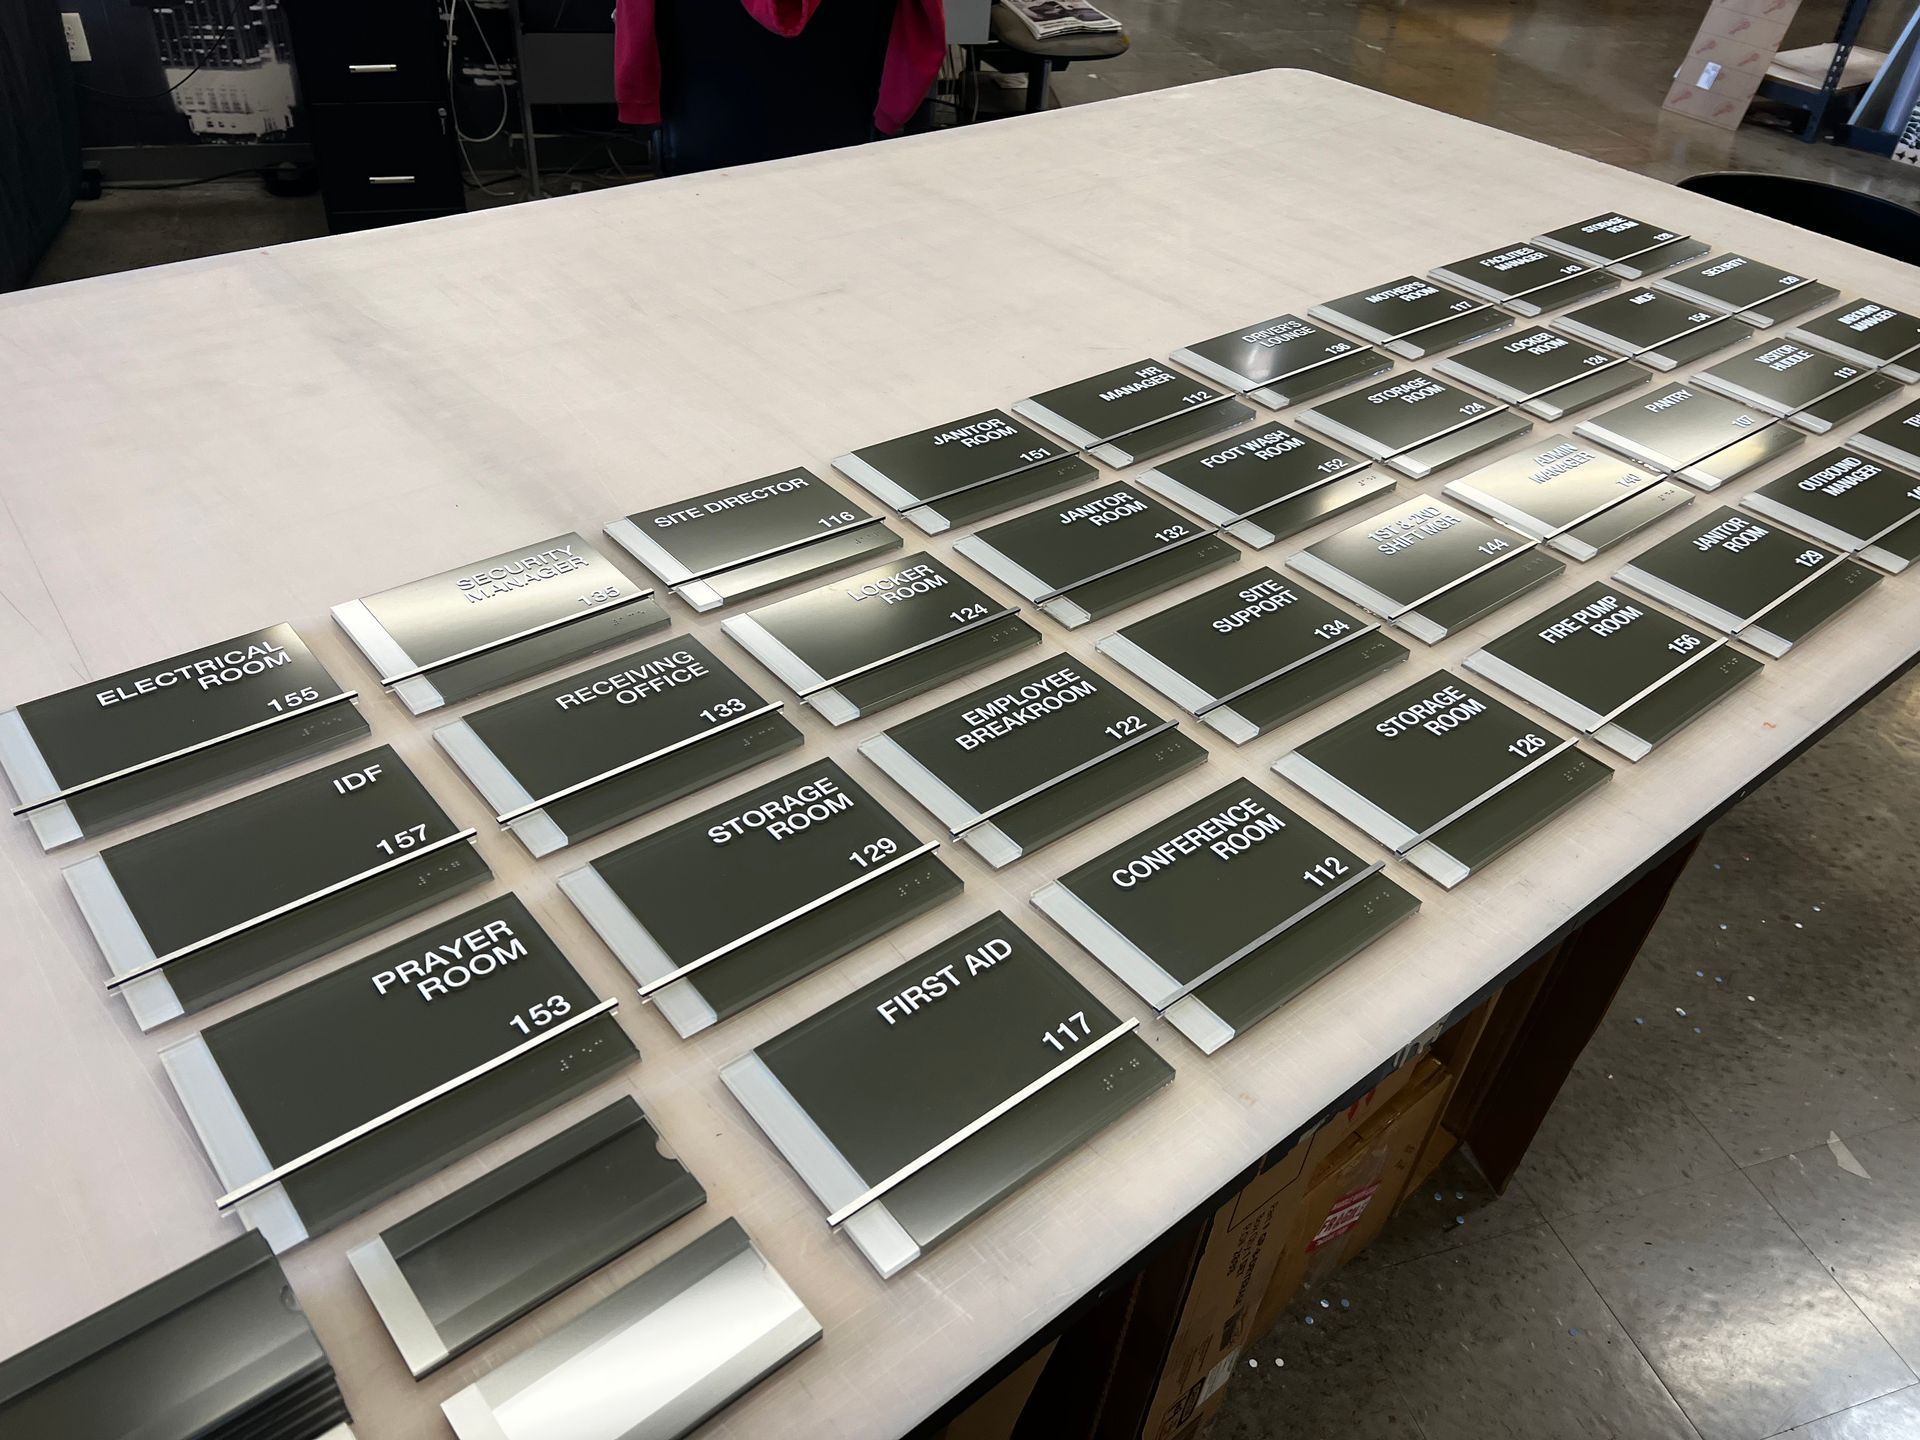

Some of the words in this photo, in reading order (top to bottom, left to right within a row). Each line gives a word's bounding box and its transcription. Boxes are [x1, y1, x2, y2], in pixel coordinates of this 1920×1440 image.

[1580, 216, 1628, 233] STORAGE
[1606, 221, 1640, 233] ROOM
[1480, 248, 1535, 266] FACILITIES
[1494, 252, 1548, 271] MANAGER
[1701, 258, 1747, 277] SECURITY
[1365, 282, 1426, 303] MOTHER'S
[1400, 286, 1439, 302] ROOM
[1450, 301, 1472, 311] 117
[1837, 304, 1881, 324] INBOUND
[1242, 320, 1302, 343] DRIVER'S
[1850, 310, 1898, 331] MANAGER
[1259, 327, 1316, 348] LOUNGE
[1504, 332, 1554, 352] LOCKER
[1528, 338, 1568, 355] ROOM
[1584, 355, 1608, 366] 124
[1754, 344, 1799, 364] VISITOR
[1769, 350, 1814, 372] HUDDLE
[1136, 366, 1162, 378] HR
[1834, 367, 1857, 378] 113
[1099, 373, 1176, 401] MANAGER
[1182, 391, 1212, 404] 112
[1368, 377, 1431, 404] STORAGE
[1401, 384, 1446, 404] ROOM
[1459, 402, 1486, 416] 124
[1644, 389, 1693, 413] PANTRY
[934, 418, 1006, 445] JANITOR
[1732, 415, 1755, 428] 107
[961, 426, 1018, 448] ROOM
[1200, 446, 1245, 468] FOOT
[1241, 430, 1290, 451] WASH
[1255, 438, 1305, 461] ROOM
[1020, 448, 1051, 462] 151
[1318, 458, 1349, 473] 152
[1529, 451, 1596, 484] MANAGER
[1534, 443, 1578, 467] ADMIN
[1798, 457, 1862, 490] OUTBOUND
[1822, 465, 1882, 496] MANAGER
[654, 507, 705, 528] SITE
[703, 477, 810, 513] DIRECTOR
[1059, 492, 1134, 524] JANITOR
[1088, 501, 1149, 526] ROOM
[818, 511, 855, 528] 116
[1368, 524, 1399, 542] 1ST
[1398, 519, 1414, 531] &
[1410, 506, 1441, 525] 2ND
[1155, 525, 1189, 542] 132
[1378, 530, 1423, 555] SHIFT
[1422, 515, 1462, 536] MGR
[1693, 517, 1749, 551] JANITOR
[1722, 526, 1769, 552] ROOM
[1478, 538, 1509, 555] 144
[1795, 550, 1823, 567] 129
[456, 545, 574, 591] SECURITY
[464, 555, 589, 604] MANAGER
[848, 564, 935, 601] LOCKER
[880, 574, 948, 605] ROOM
[1238, 579, 1284, 602] SITE
[578, 586, 620, 606] 135
[950, 603, 988, 623] 124
[1212, 590, 1298, 633] SUPPORT
[1538, 618, 1582, 644] FIRE
[1572, 595, 1619, 624] PUMP
[1590, 606, 1644, 637] ROOM
[1314, 619, 1350, 639] 134
[1668, 634, 1700, 654] 156
[96, 641, 284, 707] ELECTRICAL
[197, 651, 292, 691] ROOM
[555, 651, 695, 710] RECEIVING
[616, 662, 709, 704] OFFICE
[267, 687, 319, 712] 155
[962, 668, 1081, 727] EMPLOYEE
[700, 698, 746, 723] 133
[955, 680, 1098, 750] BREAKROOM
[1376, 685, 1467, 737] STORAGE
[1423, 698, 1487, 736] ROOM
[1105, 715, 1147, 739] 122
[1508, 733, 1546, 758] 126
[333, 764, 383, 794] IDF
[708, 777, 839, 844] STORAGE
[766, 792, 854, 840] ROOM
[376, 823, 426, 855] 157
[1112, 797, 1265, 888] CONFERENCE
[1210, 813, 1286, 861] ROOM
[849, 837, 898, 867] 129
[1303, 856, 1349, 887] 112
[372, 919, 514, 995] PRAYER
[416, 938, 528, 1002] ROOM
[877, 964, 961, 1025] FIRST
[965, 938, 1012, 976] AID
[510, 994, 572, 1034] 153
[1042, 1011, 1091, 1051] 117
